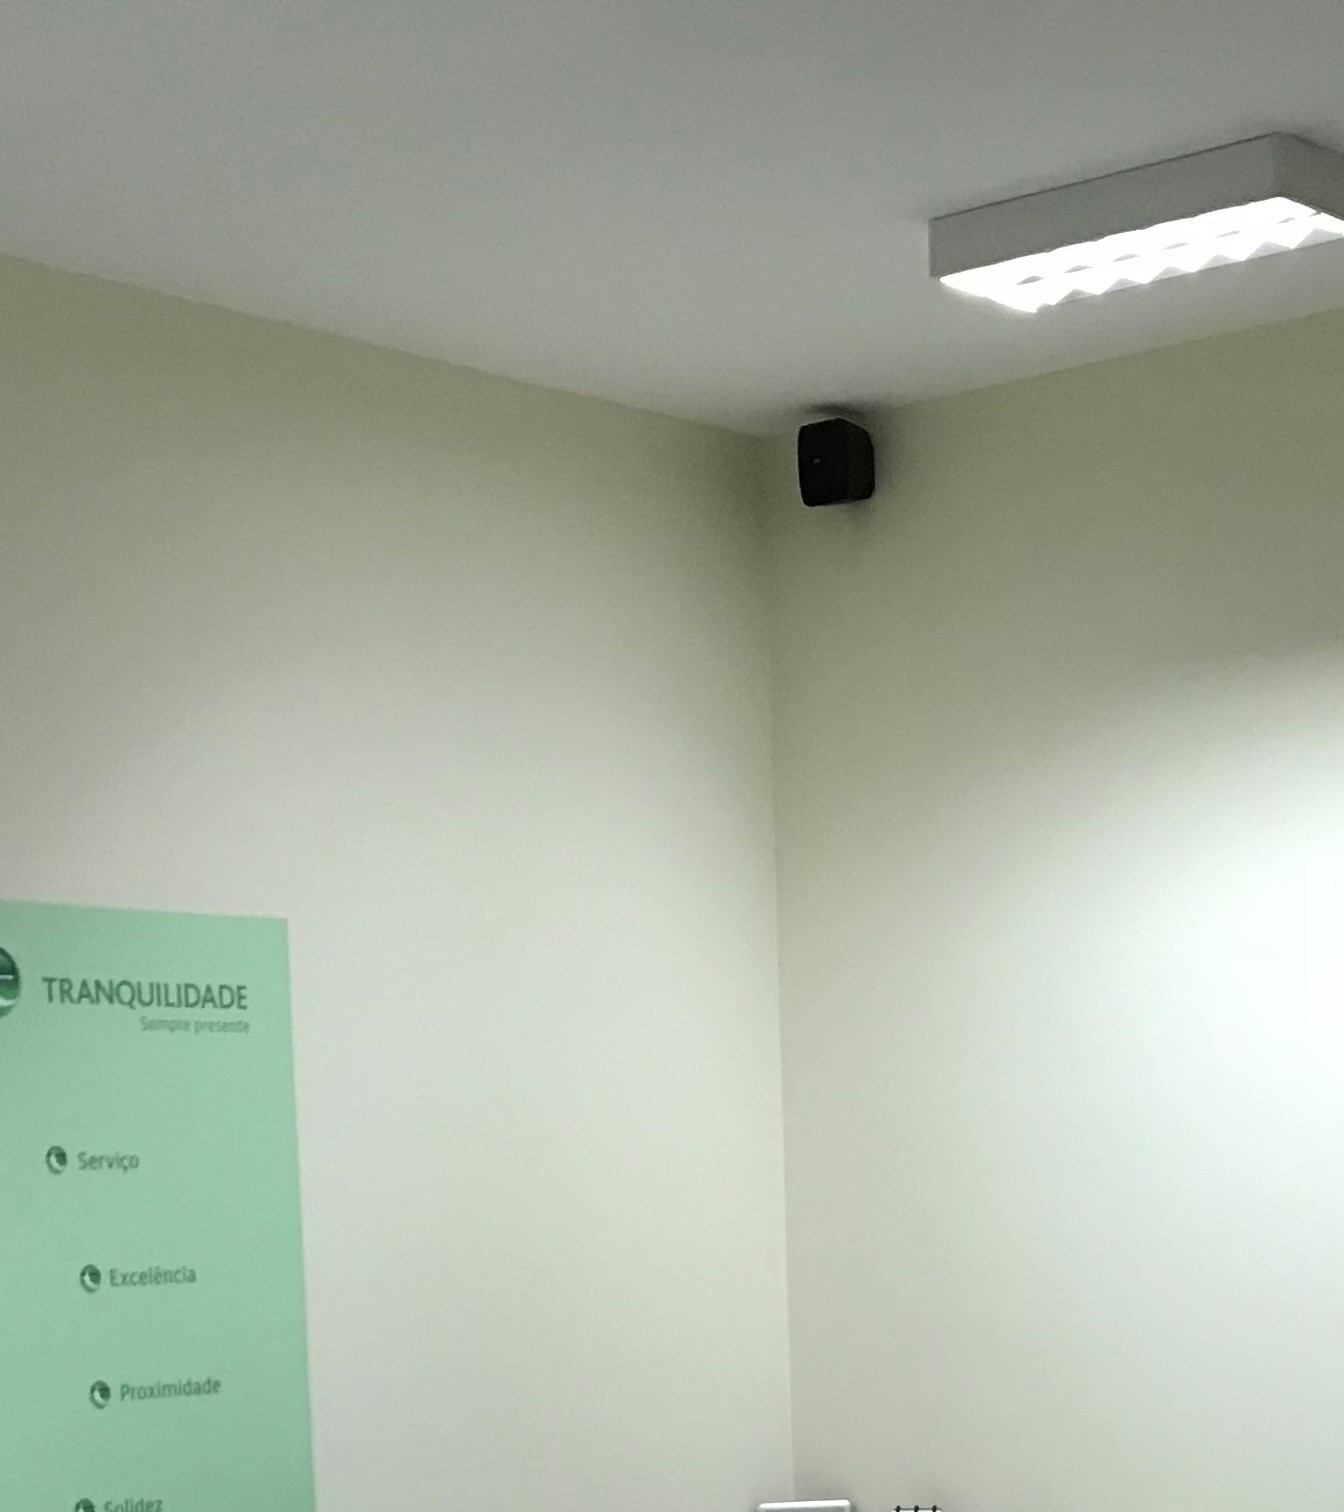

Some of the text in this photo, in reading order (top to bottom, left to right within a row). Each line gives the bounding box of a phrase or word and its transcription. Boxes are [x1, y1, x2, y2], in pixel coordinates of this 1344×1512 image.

[41, 976, 248, 1011] TRANQUILIDADE
[139, 1015, 251, 1035] Sempre presente
[76, 1151, 140, 1174] Serviço
[108, 1265, 197, 1288] Excelência
[119, 1376, 222, 1402] Proximidade
